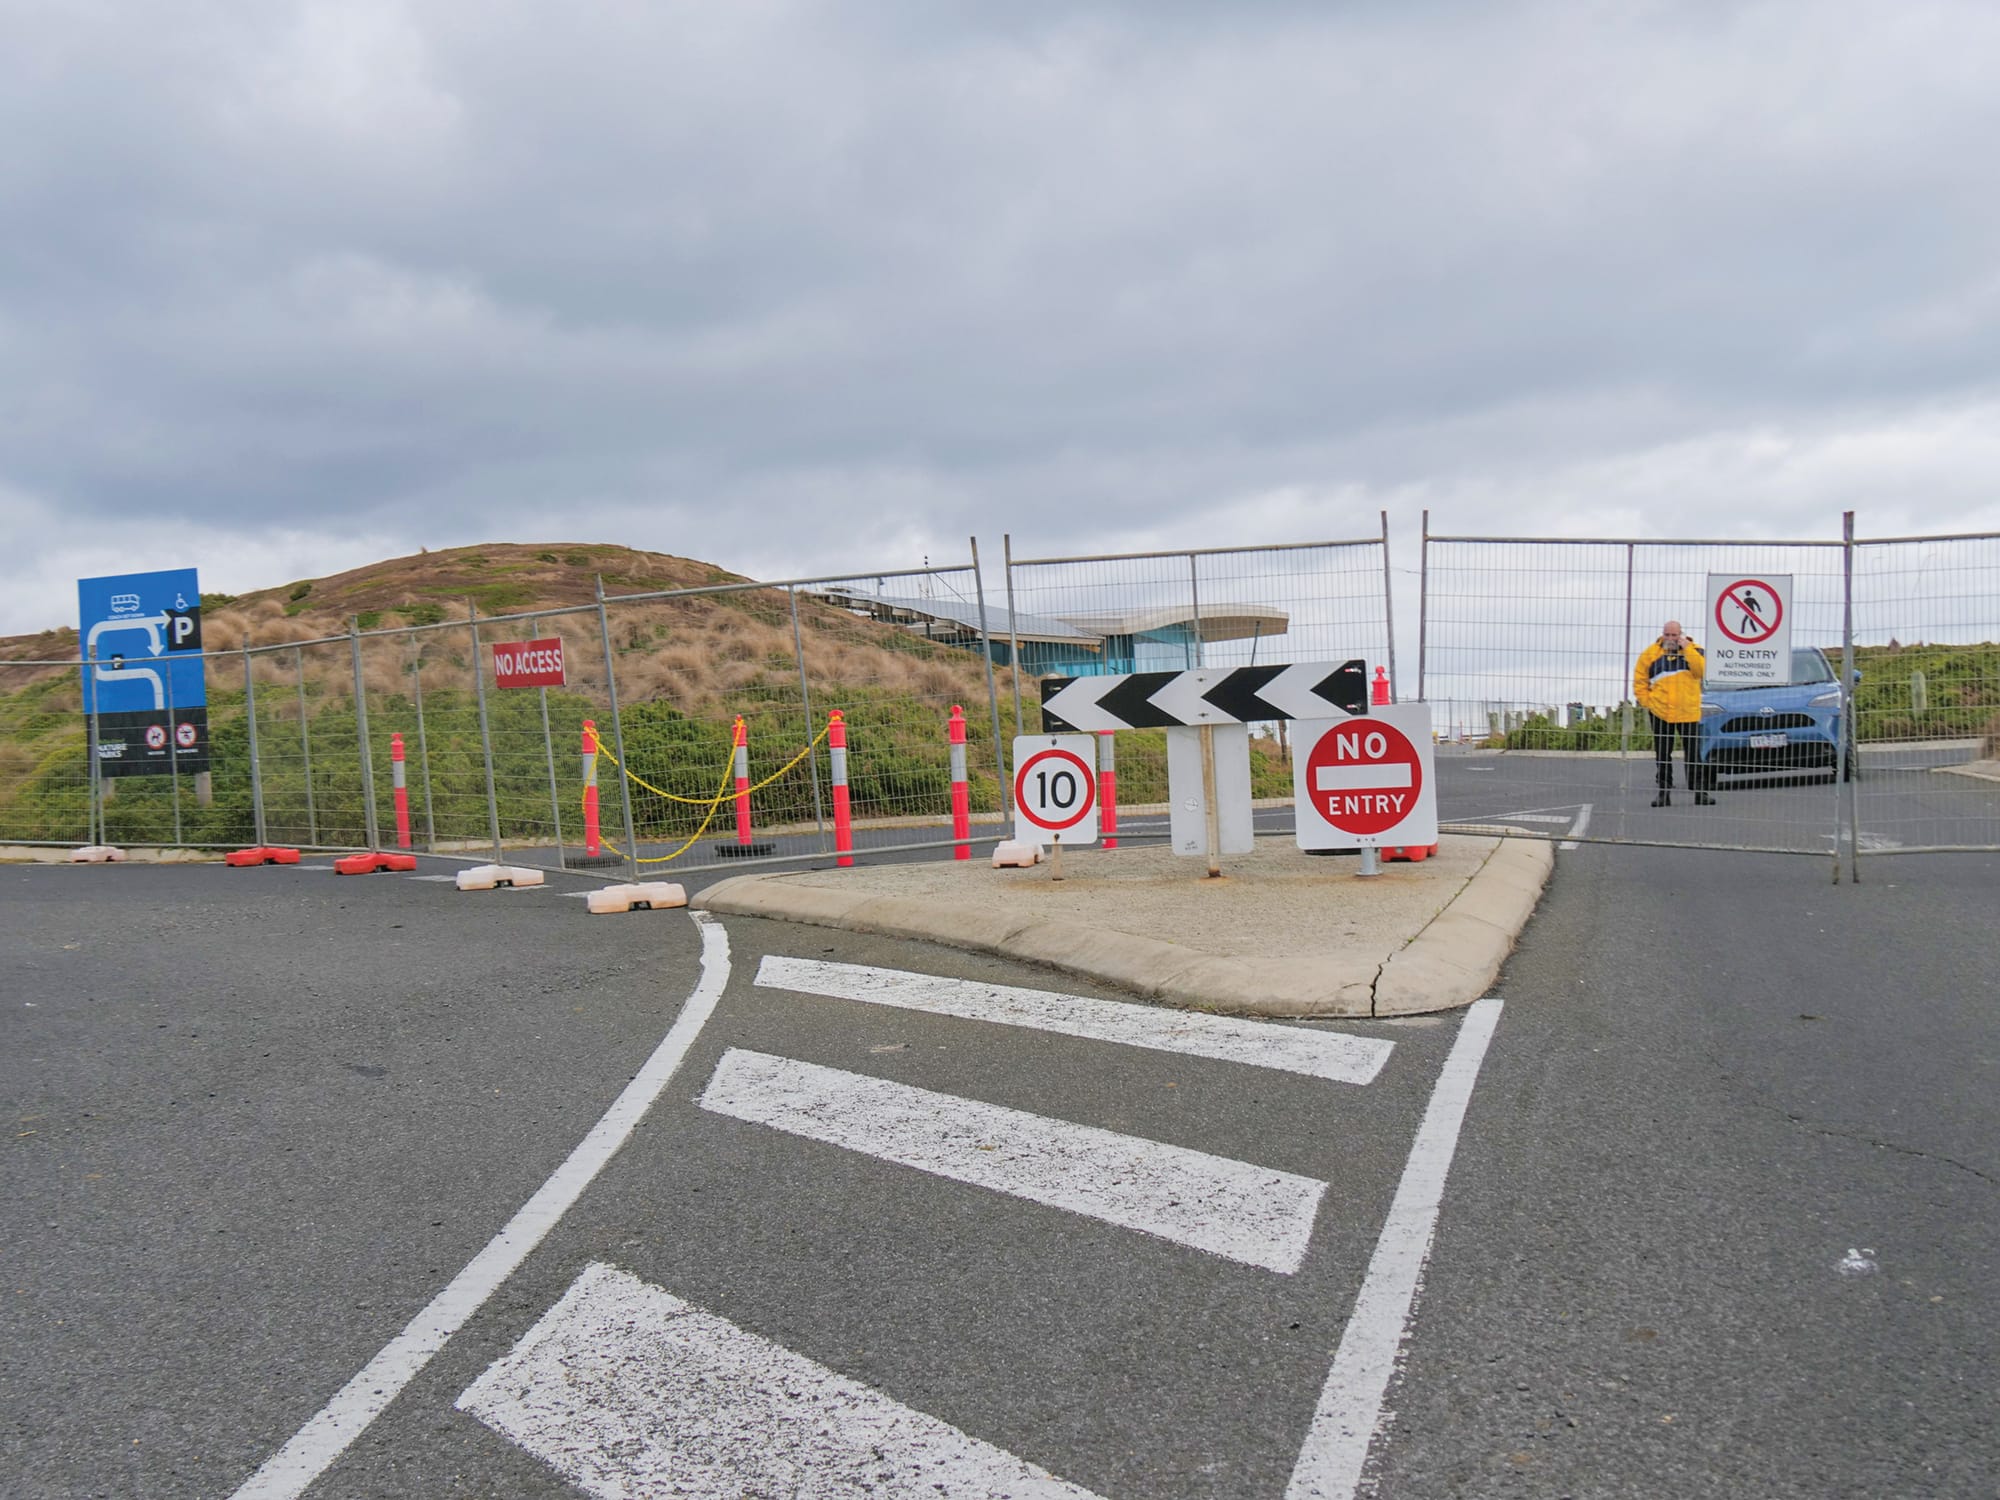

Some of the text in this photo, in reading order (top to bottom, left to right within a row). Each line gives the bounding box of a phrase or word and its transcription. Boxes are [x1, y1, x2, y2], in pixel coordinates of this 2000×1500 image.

[175, 617, 194, 644] P
[495, 649, 562, 676] NO ACCESS
[1716, 649, 1778, 660] NO ENTRY
[1724, 662, 1772, 670] AUTHORISED
[1718, 670, 1776, 678] PERSONS ONLY
[1336, 732, 1388, 761] NO
[1036, 770, 1077, 809] 10
[1328, 793, 1406, 816] ENTRY
